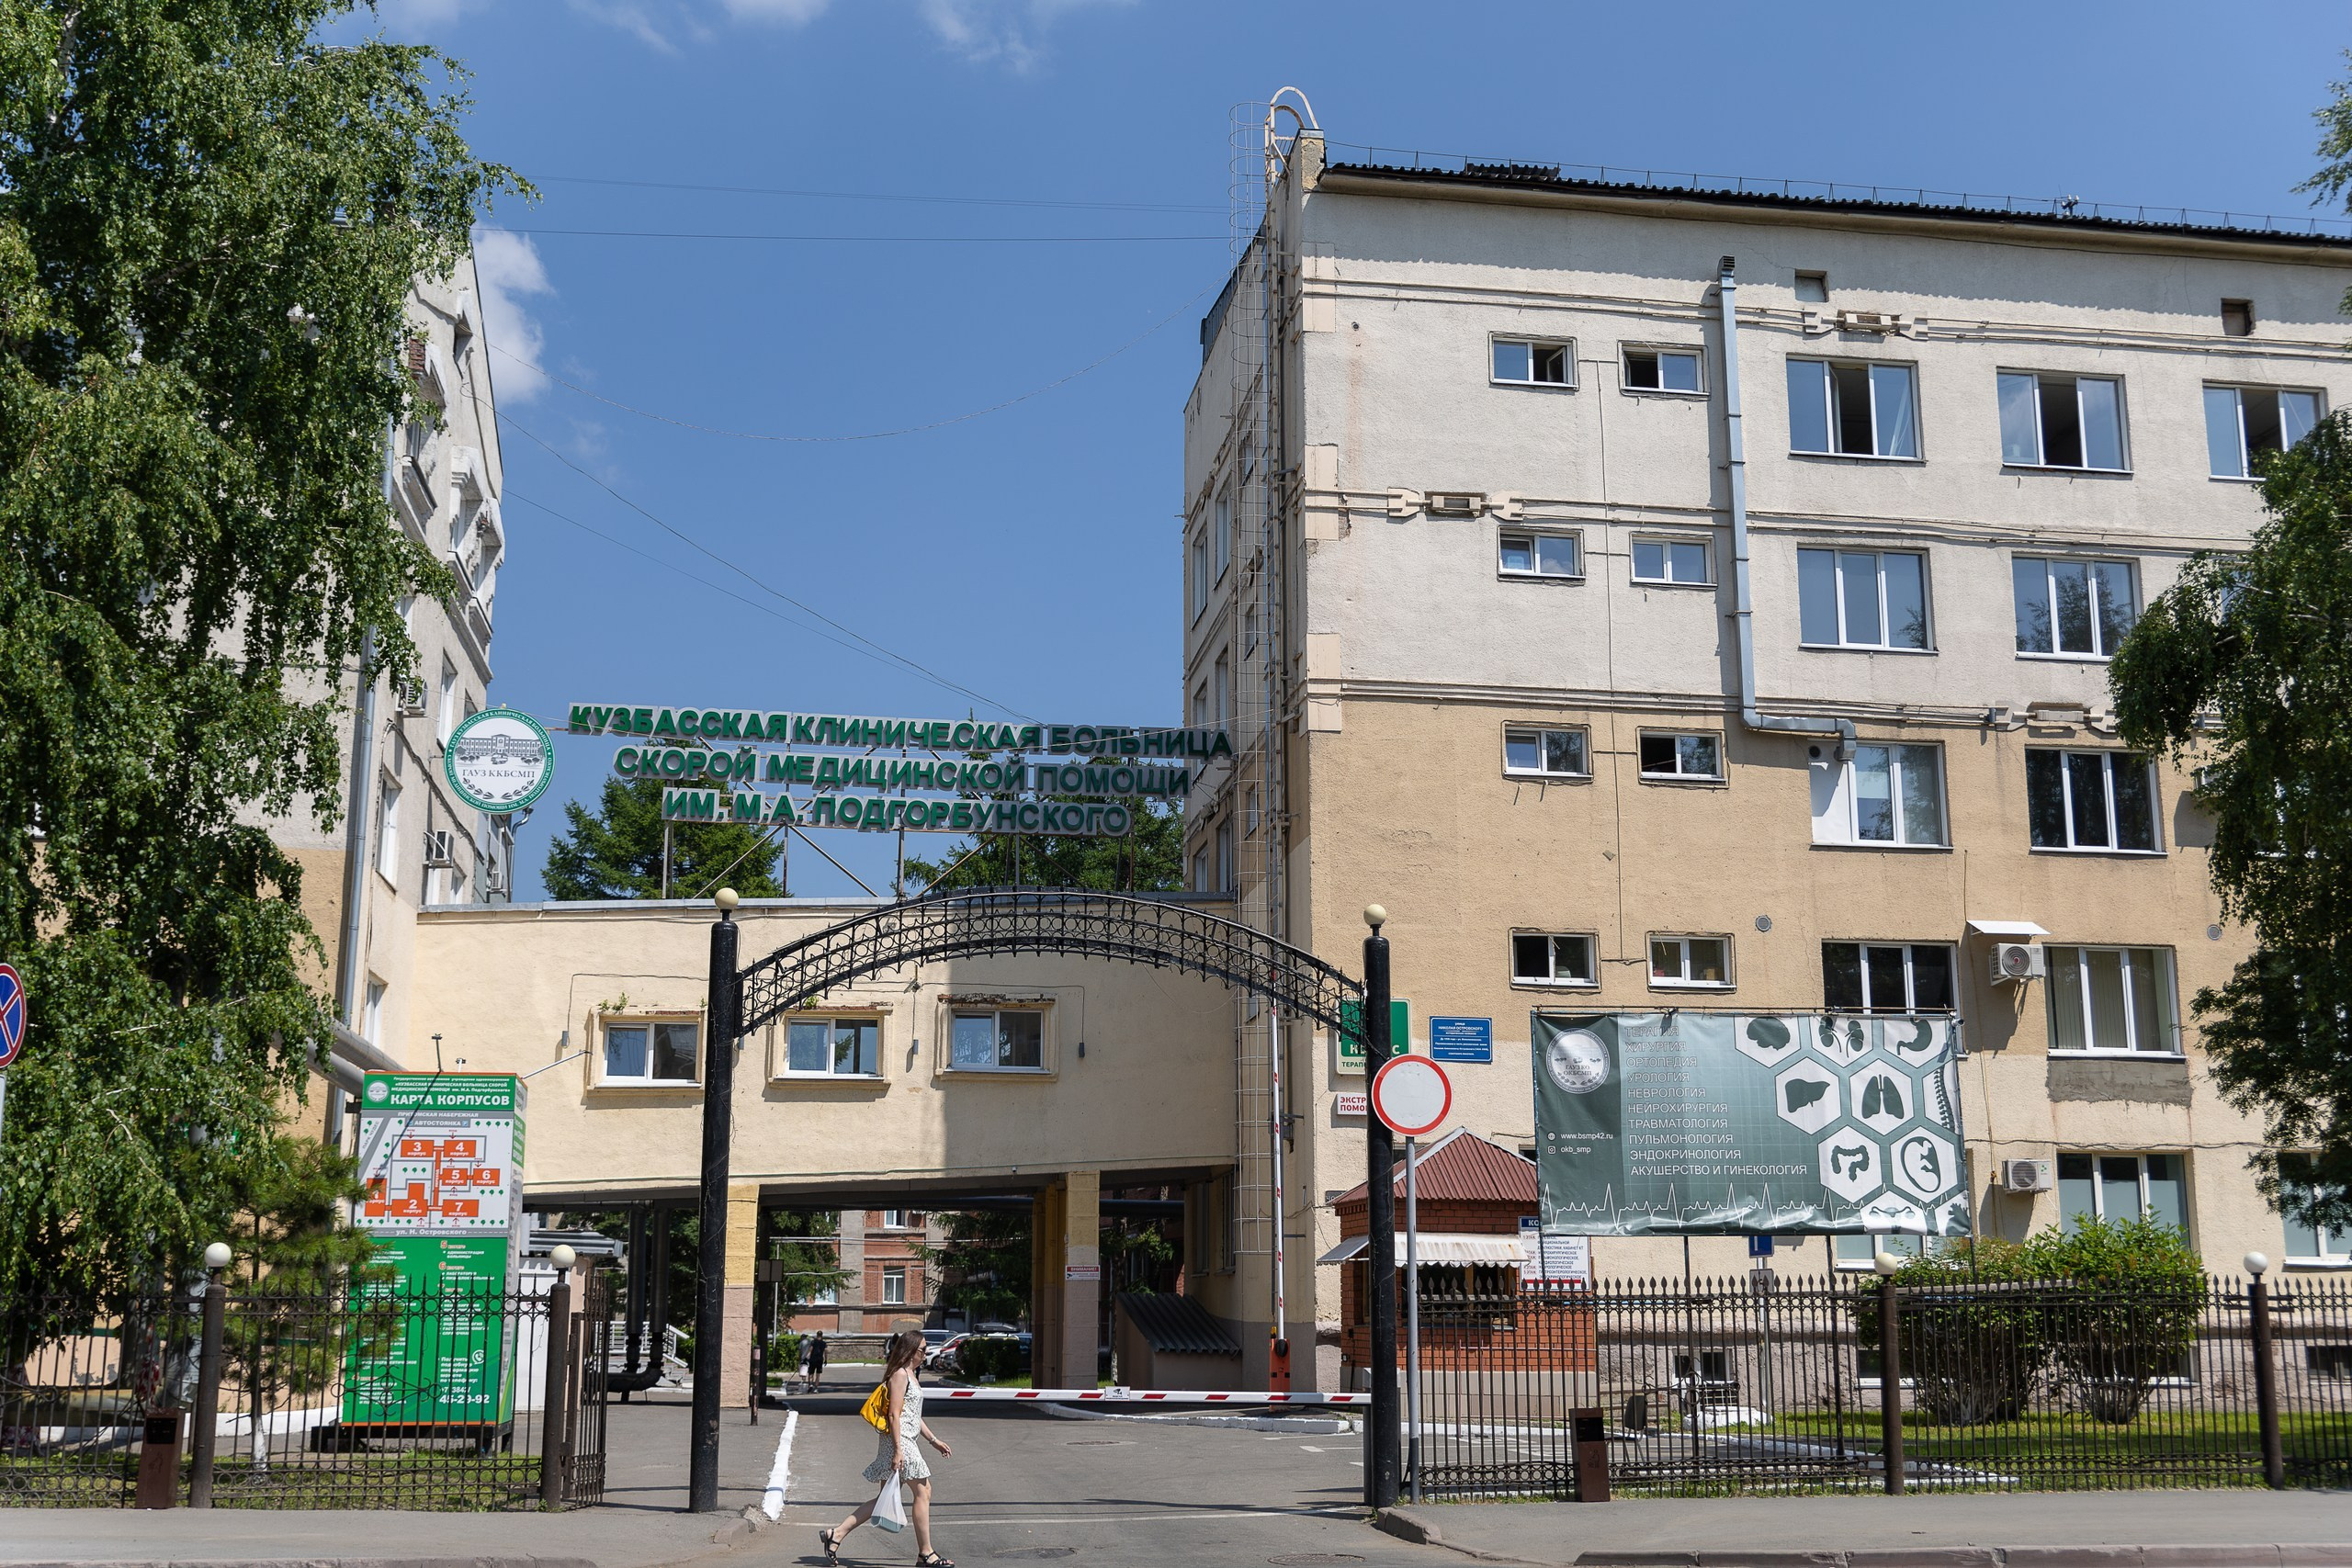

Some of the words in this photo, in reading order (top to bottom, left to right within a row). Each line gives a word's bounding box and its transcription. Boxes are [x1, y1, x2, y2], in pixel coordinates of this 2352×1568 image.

[571, 705, 787, 741] КУЗБАССКАЯ
[794, 716, 1041, 750] КЛИНИЧЕСКАЯ
[1051, 726, 1234, 759] БОЛЬНИЦА
[462, 769, 486, 777] ГАУЗ
[489, 770, 535, 778] ККБСМП
[616, 746, 756, 781] СКОРОЙ
[768, 755, 1027, 791] МЕДИЦИНСКОЙ
[1037, 766, 1190, 798] ПОМОЩИ
[666, 791, 725, 818] ИМ.
[814, 797, 1129, 831] ПОДГОРБУНСКОГО
[1625, 1026, 1679, 1038] ТЕРАПИЯ
[1625, 1042, 1687, 1053] ХИРУРГИЯ
[1626, 1057, 1698, 1068] ОРТОПЕДИЯ
[1626, 1072, 1690, 1084] УРОЛОГИЯ
[1627, 1088, 1706, 1099] НЕВРОЛОГИЯ
[390, 1094, 433, 1105] КАРТА
[437, 1095, 510, 1106] КОРПУСОВ
[1628, 1102, 1728, 1114] НЕЙРОХИРУРГИЯ
[1628, 1118, 1728, 1129] ТРАВМАТОЛОГИЯ
[1560, 1133, 1613, 1141] www.bsmp42.ru
[1629, 1134, 1734, 1145] ПУЛЬМОНОЛОГИЯ
[413, 1142, 422, 1152] 3
[455, 1142, 464, 1152] 4
[1630, 1149, 1742, 1161] ЭНДОКРИНОЛОГИЯ
[451, 1169, 459, 1179] 5
[482, 1169, 491, 1179] 6
[1630, 1165, 1710, 1176] АКУШЕРСТВО
[1713, 1165, 1721, 1176] И
[1724, 1164, 1808, 1176] ГИНЕКОЛОГИЯ
[409, 1200, 418, 1210] 2
[455, 1202, 463, 1212] 7
